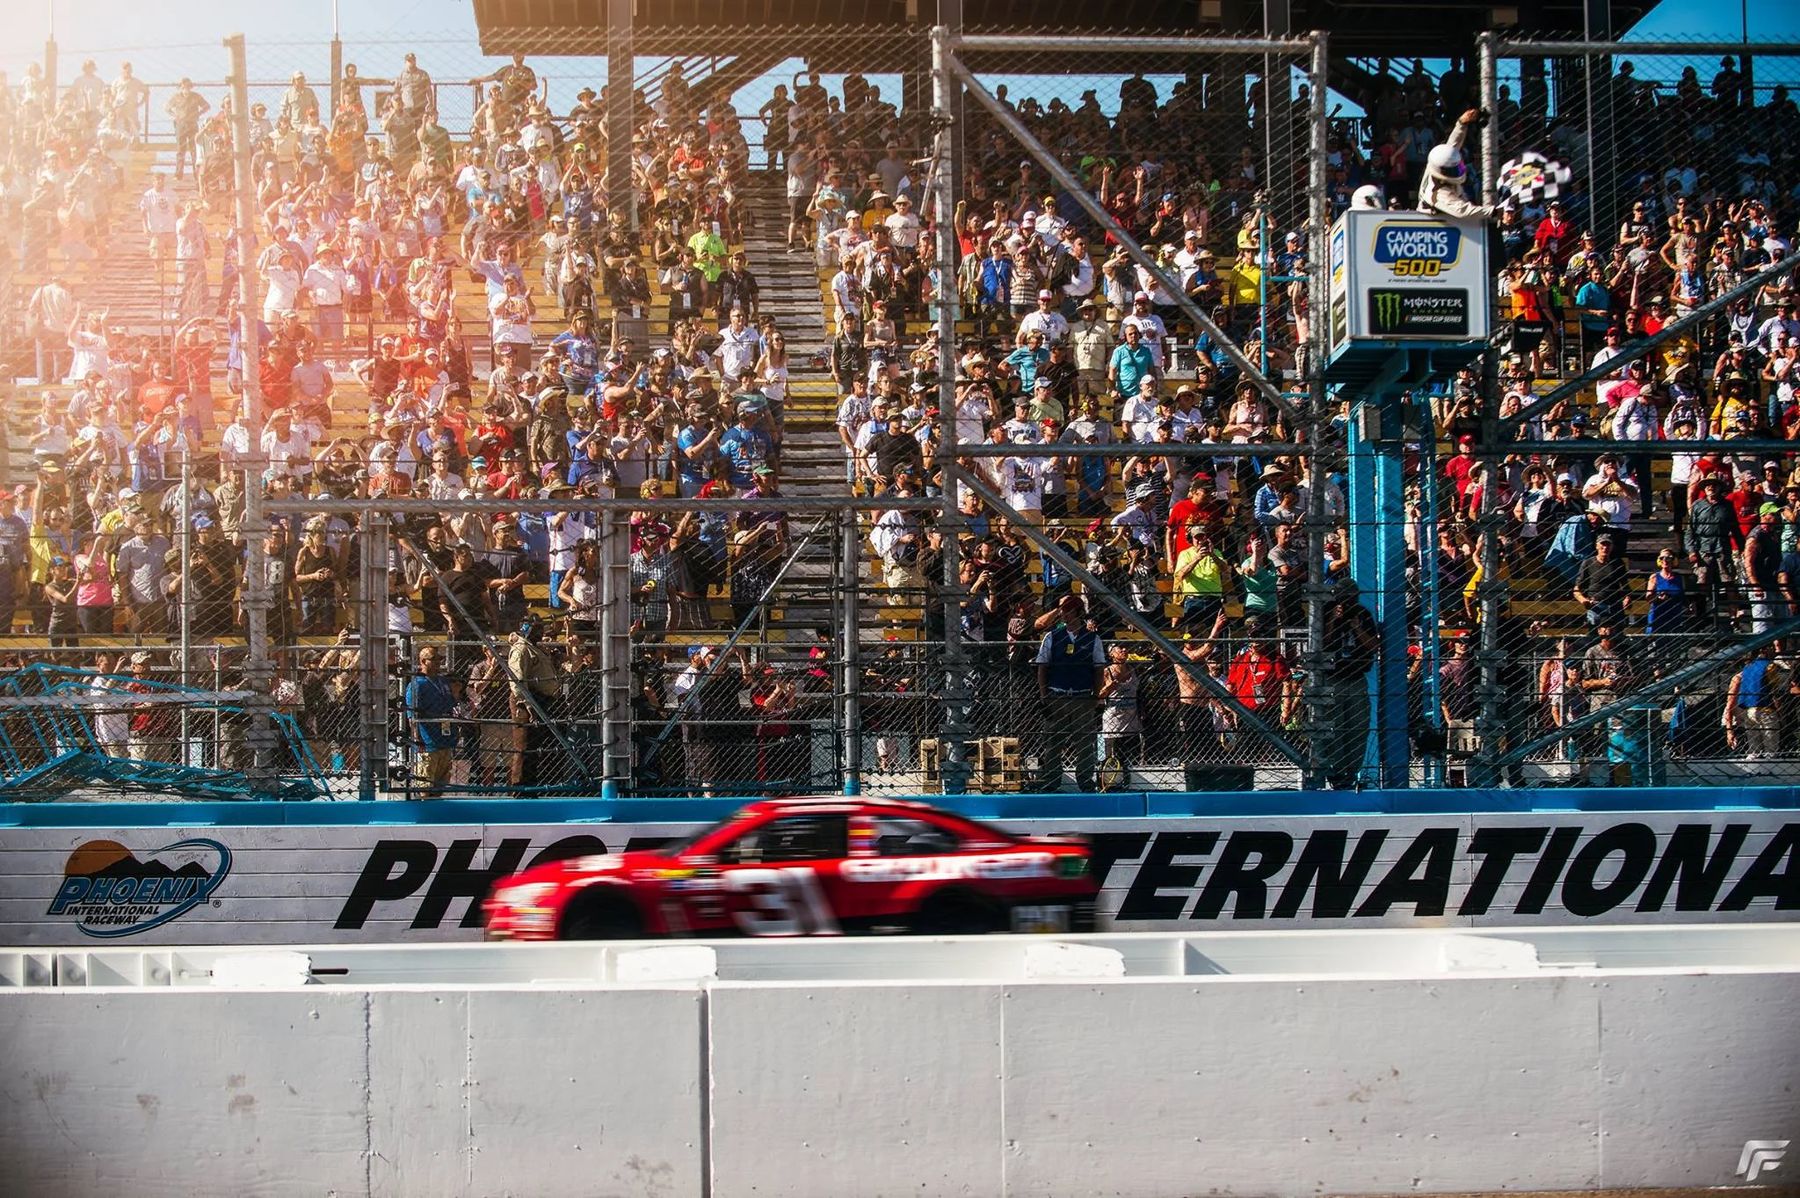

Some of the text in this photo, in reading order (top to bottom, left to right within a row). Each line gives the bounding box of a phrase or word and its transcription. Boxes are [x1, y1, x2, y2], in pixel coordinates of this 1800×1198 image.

[1386, 231, 1448, 243] CAMPING
[1387, 243, 1448, 257] WORLD
[1393, 259, 1442, 276] 500
[1403, 296, 1463, 308] MONSTER
[47, 877, 210, 915] PHOENIX
[67, 905, 160, 915] INTERNATIONAL
[83, 915, 140, 925] RACEWAY
